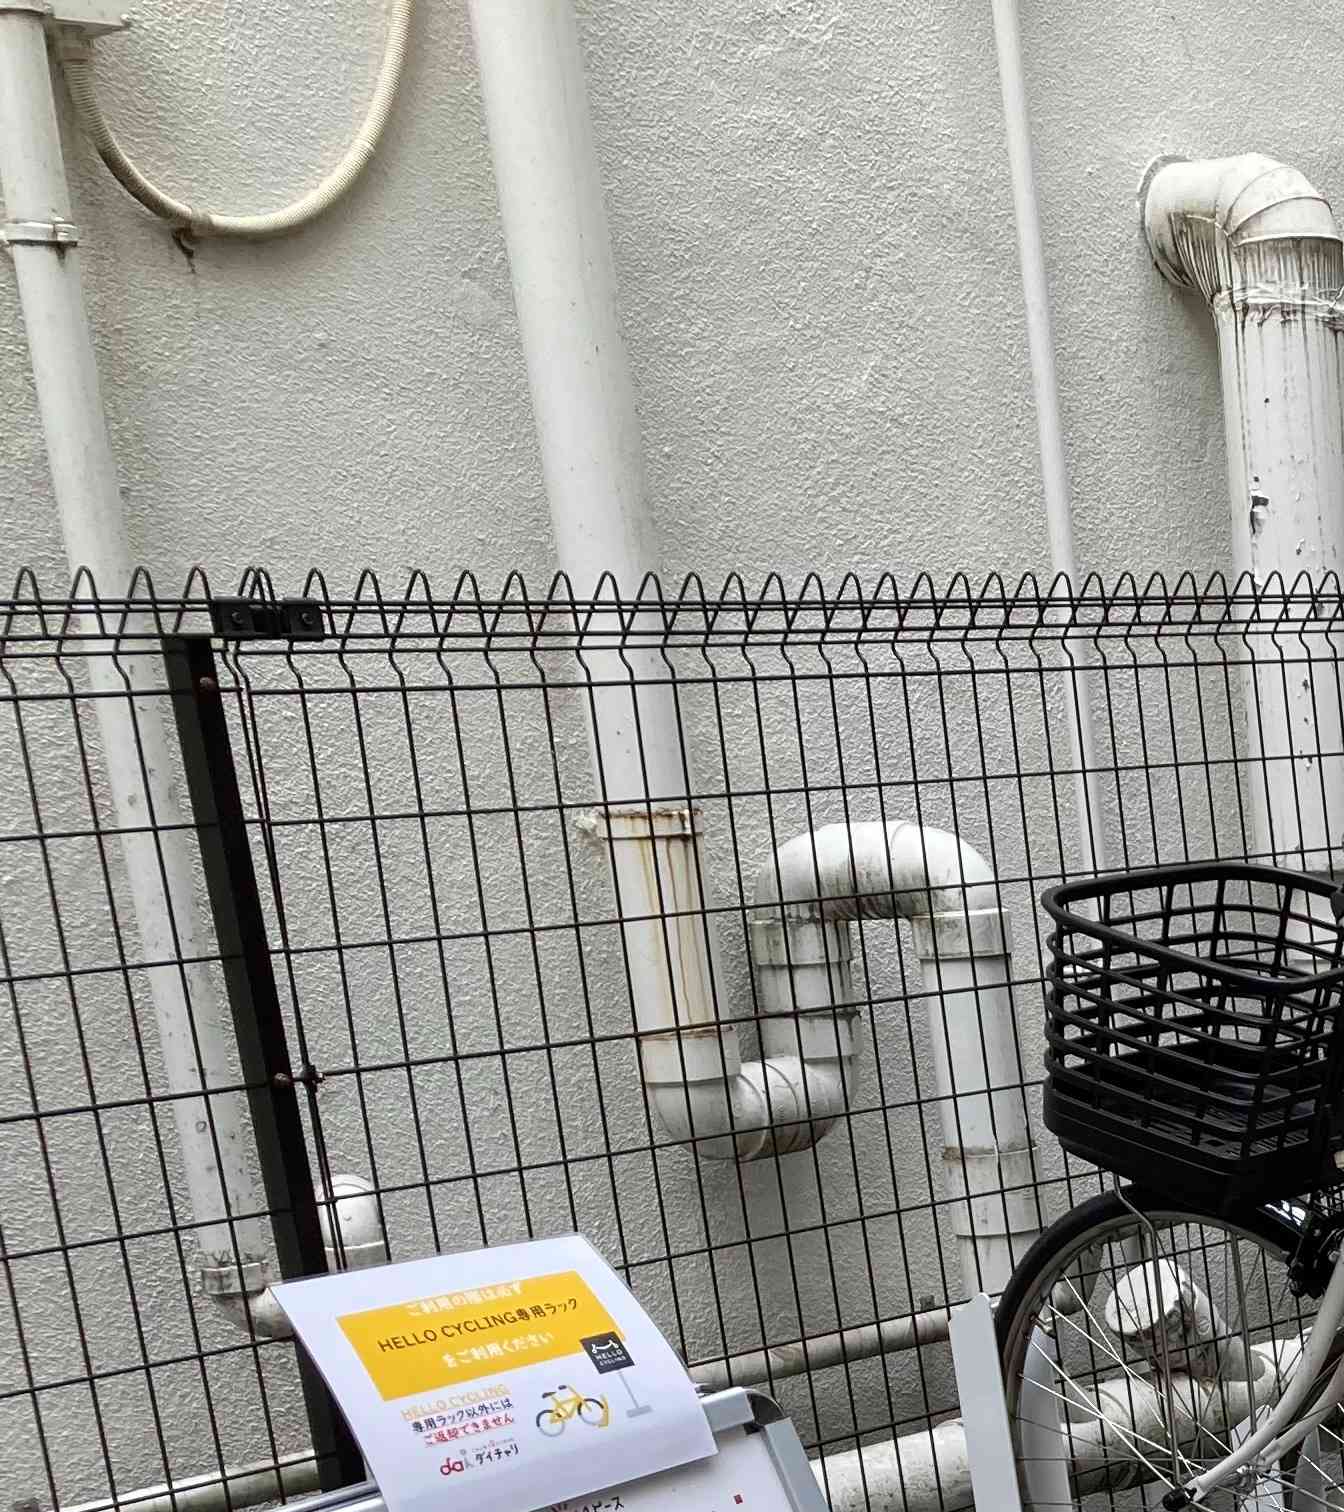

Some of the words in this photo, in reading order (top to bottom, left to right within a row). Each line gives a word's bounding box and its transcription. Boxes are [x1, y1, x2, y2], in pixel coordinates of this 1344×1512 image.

[377, 1329, 437, 1353] HELLO
[440, 1298, 578, 1338] CYCLING専用ラック
[442, 1331, 554, 1368] をご利用ください
[411, 1397, 513, 1434] 専用ラック以外には
[424, 1414, 515, 1446] ご返却できません
[475, 1444, 519, 1465] ダイチャリ
